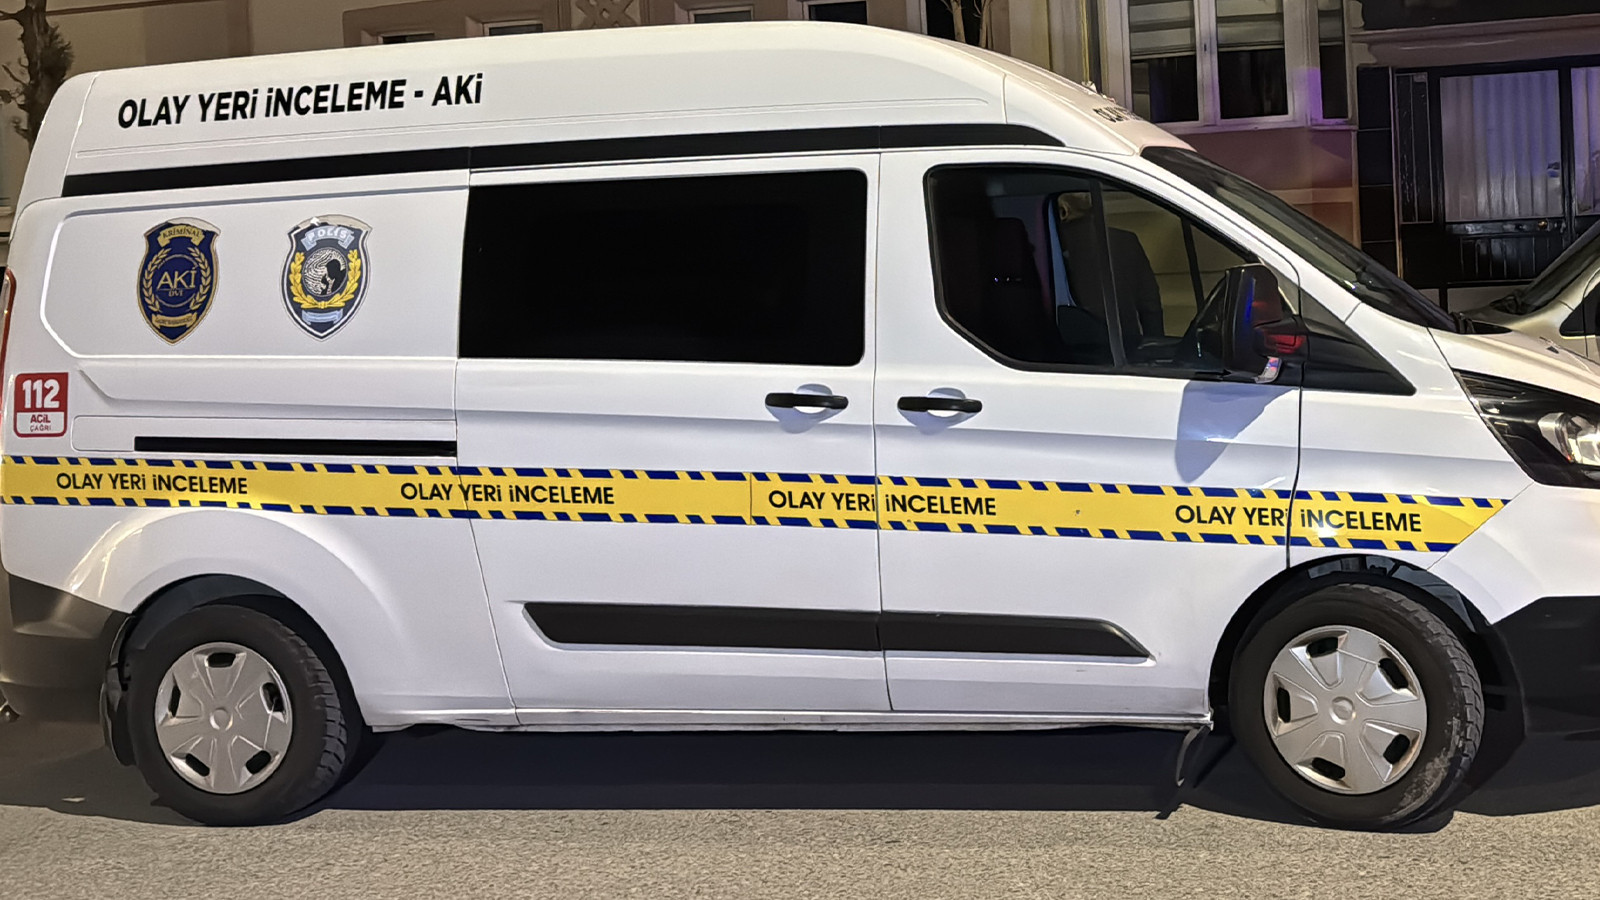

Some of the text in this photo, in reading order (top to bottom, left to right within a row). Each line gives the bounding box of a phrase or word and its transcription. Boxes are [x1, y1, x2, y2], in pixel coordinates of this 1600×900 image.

[118, 95, 191, 129] OLAY
[22, 379, 60, 409] 112
[56, 472, 103, 490] OLAY
[400, 482, 453, 501] OLAY
[768, 490, 826, 510] OLAY
[1175, 504, 1236, 525] OLAY
